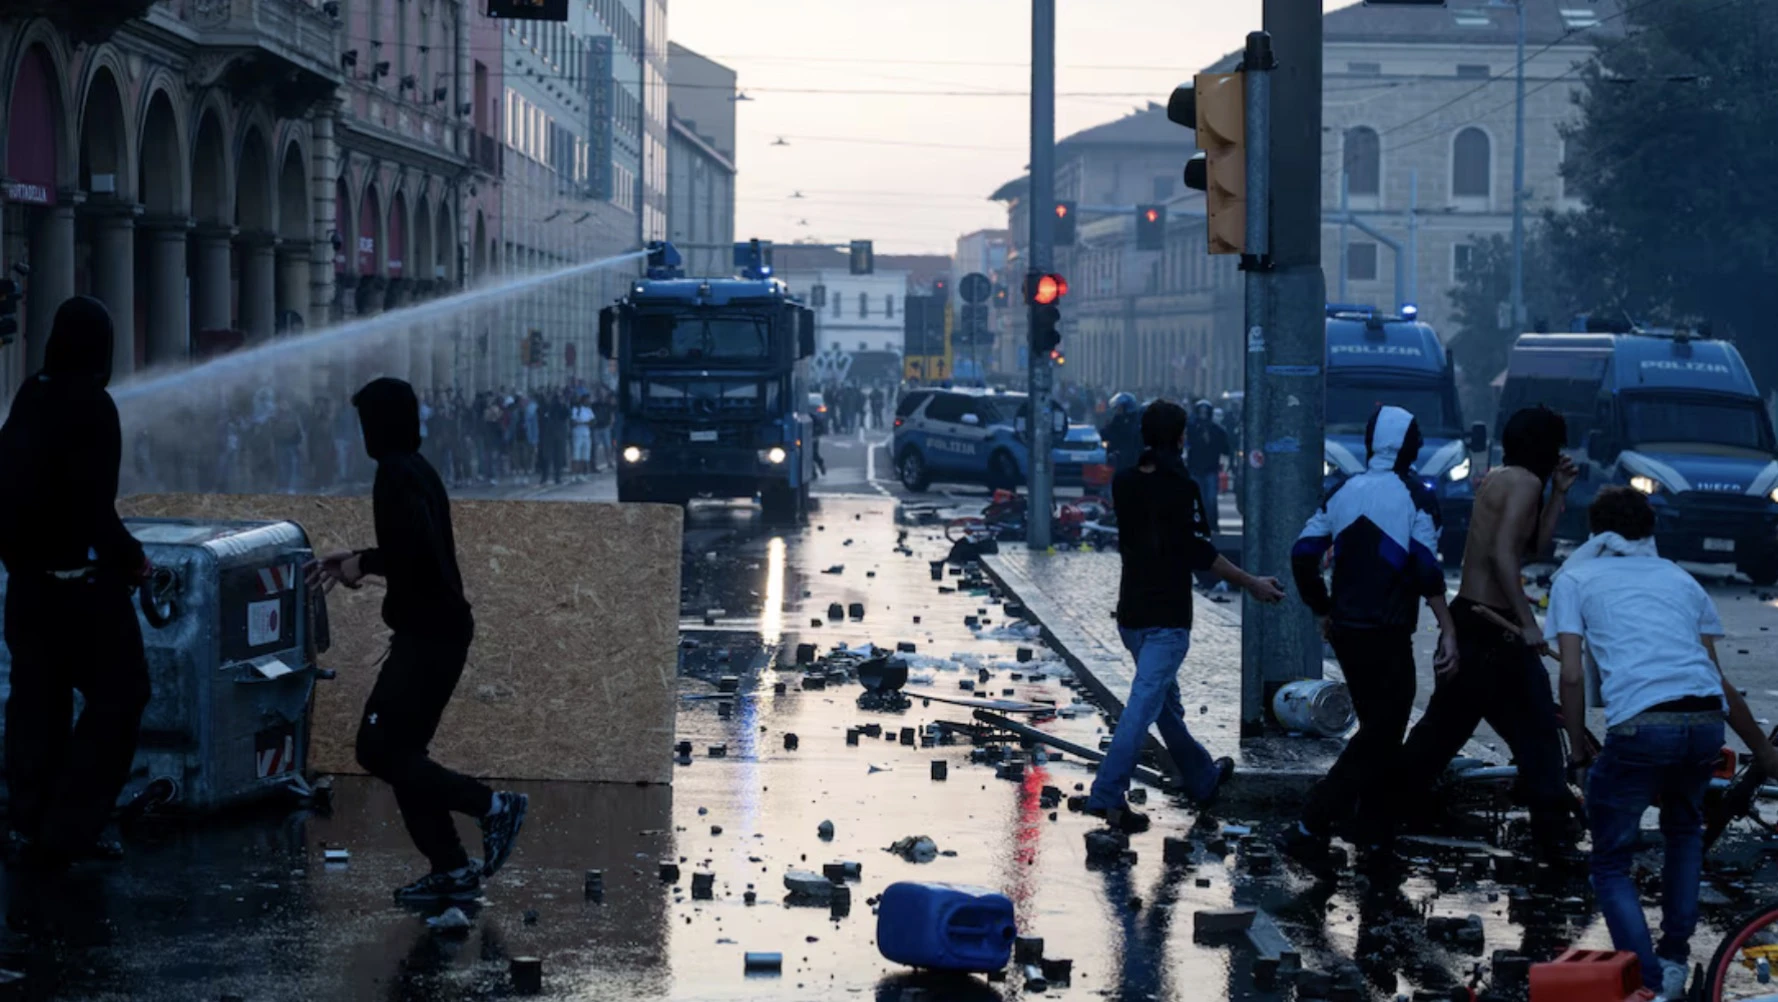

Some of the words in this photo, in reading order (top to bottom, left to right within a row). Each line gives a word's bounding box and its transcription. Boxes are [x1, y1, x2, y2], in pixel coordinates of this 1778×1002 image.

[1331, 345, 1422, 356] POLIZIA
[1641, 360, 1729, 373] POLIZIA
[926, 437, 977, 455] POLIZIA
[1698, 482, 1741, 492] IVECO
